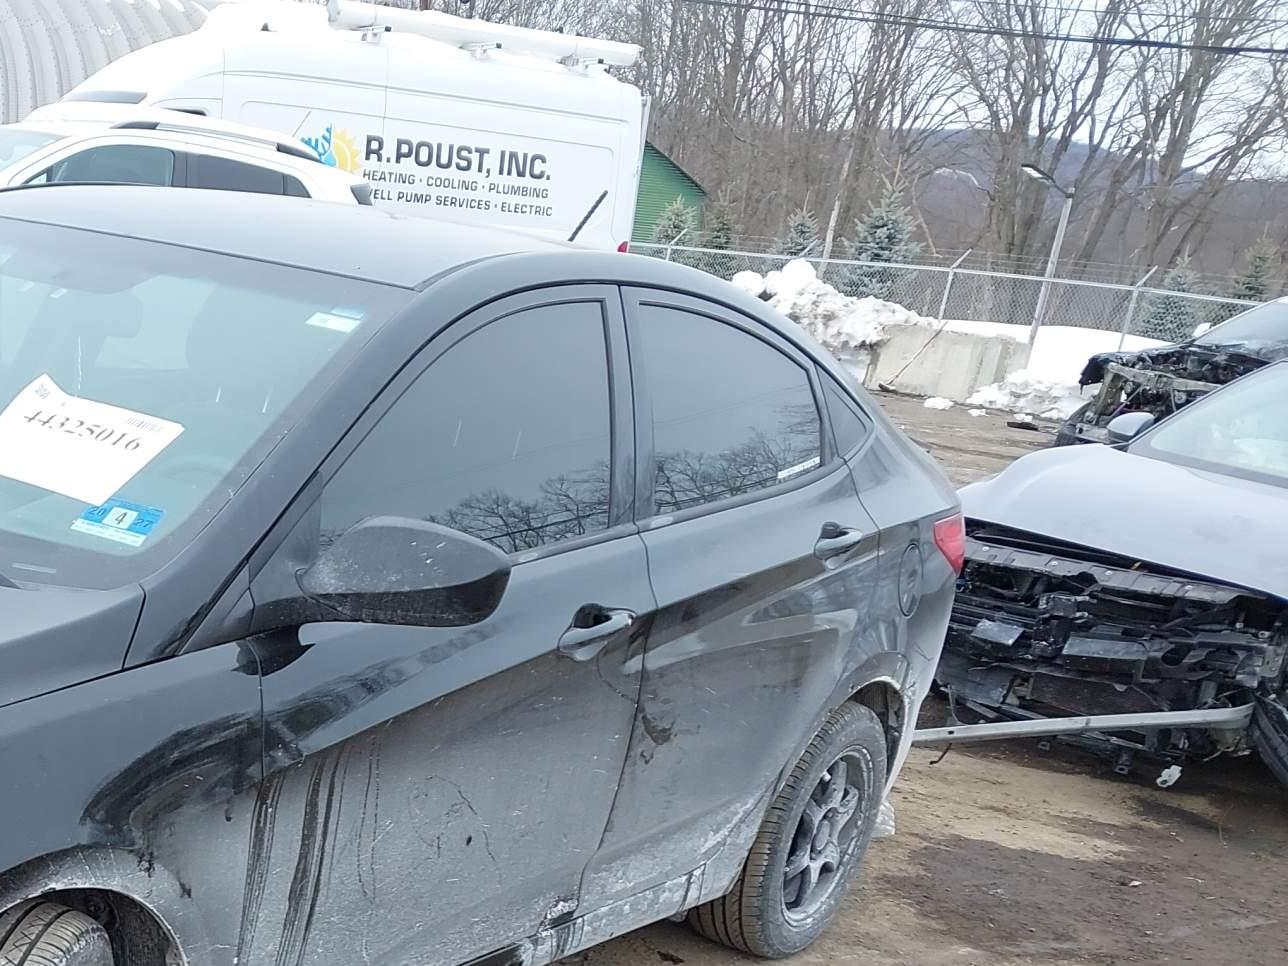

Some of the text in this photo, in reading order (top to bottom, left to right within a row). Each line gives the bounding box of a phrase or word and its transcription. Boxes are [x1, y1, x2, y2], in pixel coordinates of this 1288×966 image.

[498, 150, 551, 180] INC.
[363, 169, 549, 199] HEATING COOLING PLUMBING
[369, 188, 553, 217] ELL PUMP SERVICES ELECTRIC
[23, 410, 143, 450] 44325016
[114, 511, 128, 525] 4
